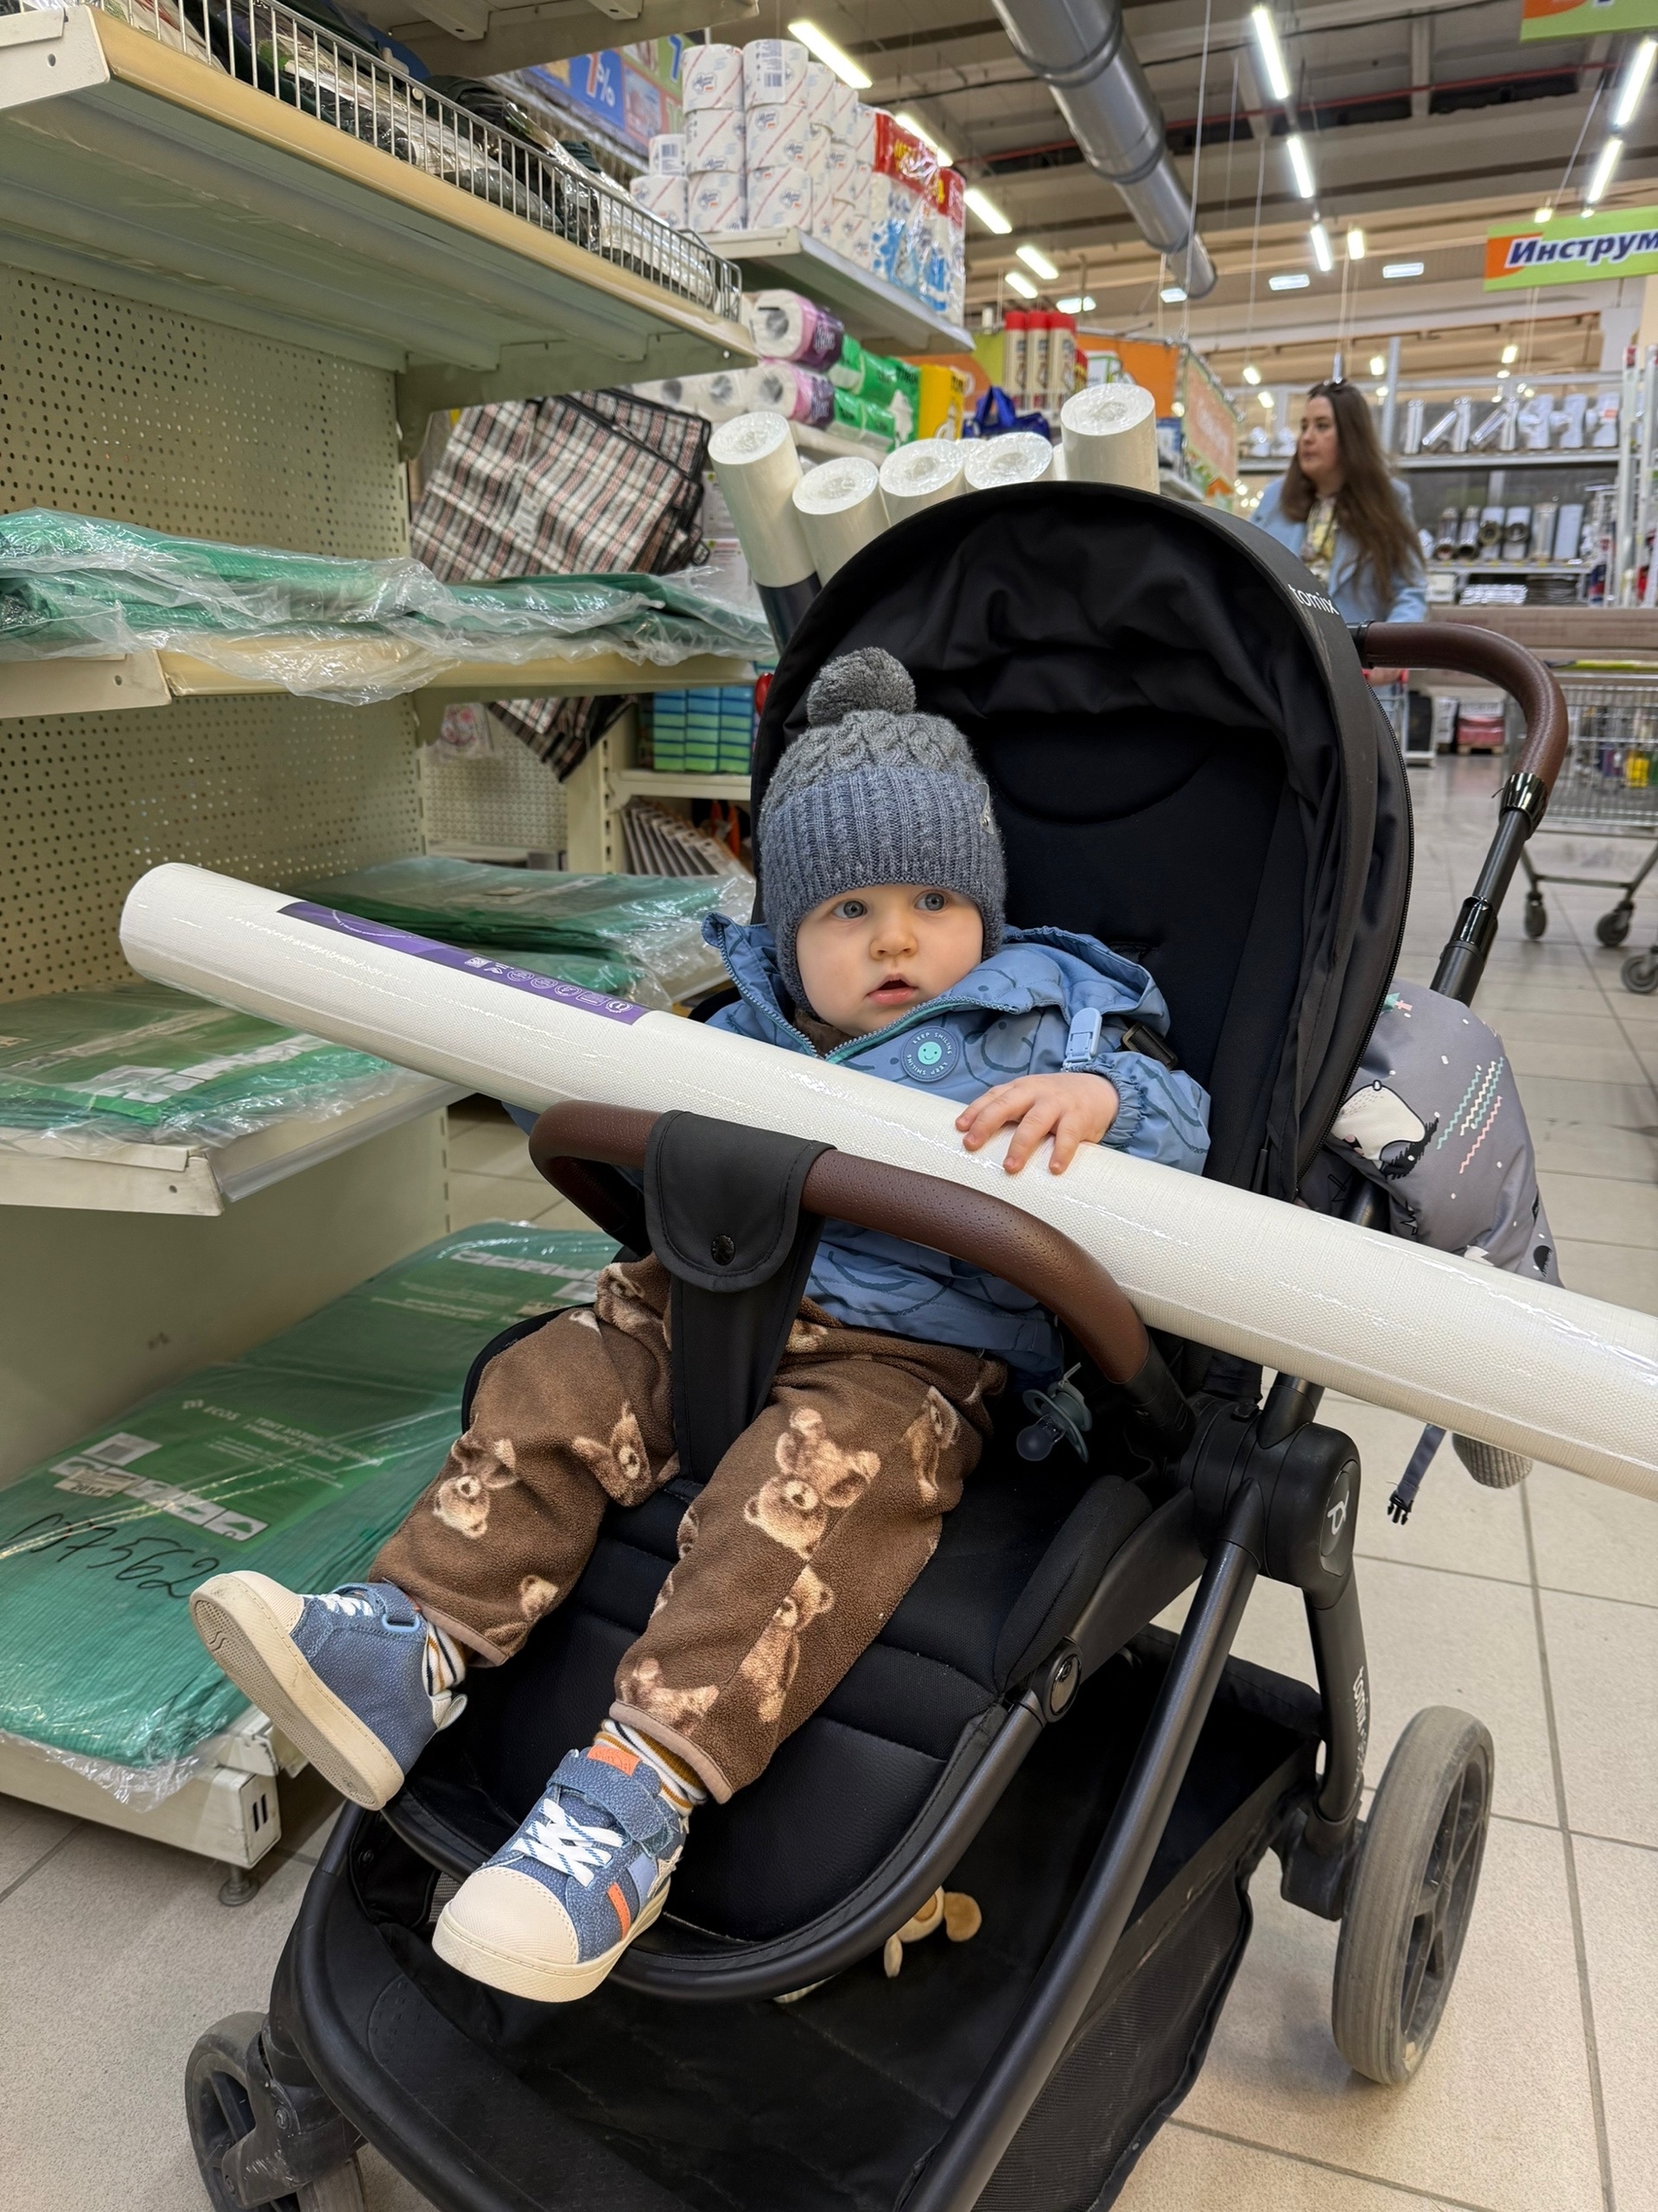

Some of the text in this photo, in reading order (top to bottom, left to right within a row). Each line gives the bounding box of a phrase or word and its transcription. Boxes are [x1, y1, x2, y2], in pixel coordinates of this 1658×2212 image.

[1508, 231, 1658, 265] Инструм
[1287, 583, 1340, 615] tomix
[912, 1032, 953, 1055] KEEP SMILING
[906, 1053, 949, 1076] KEEP SMILING
